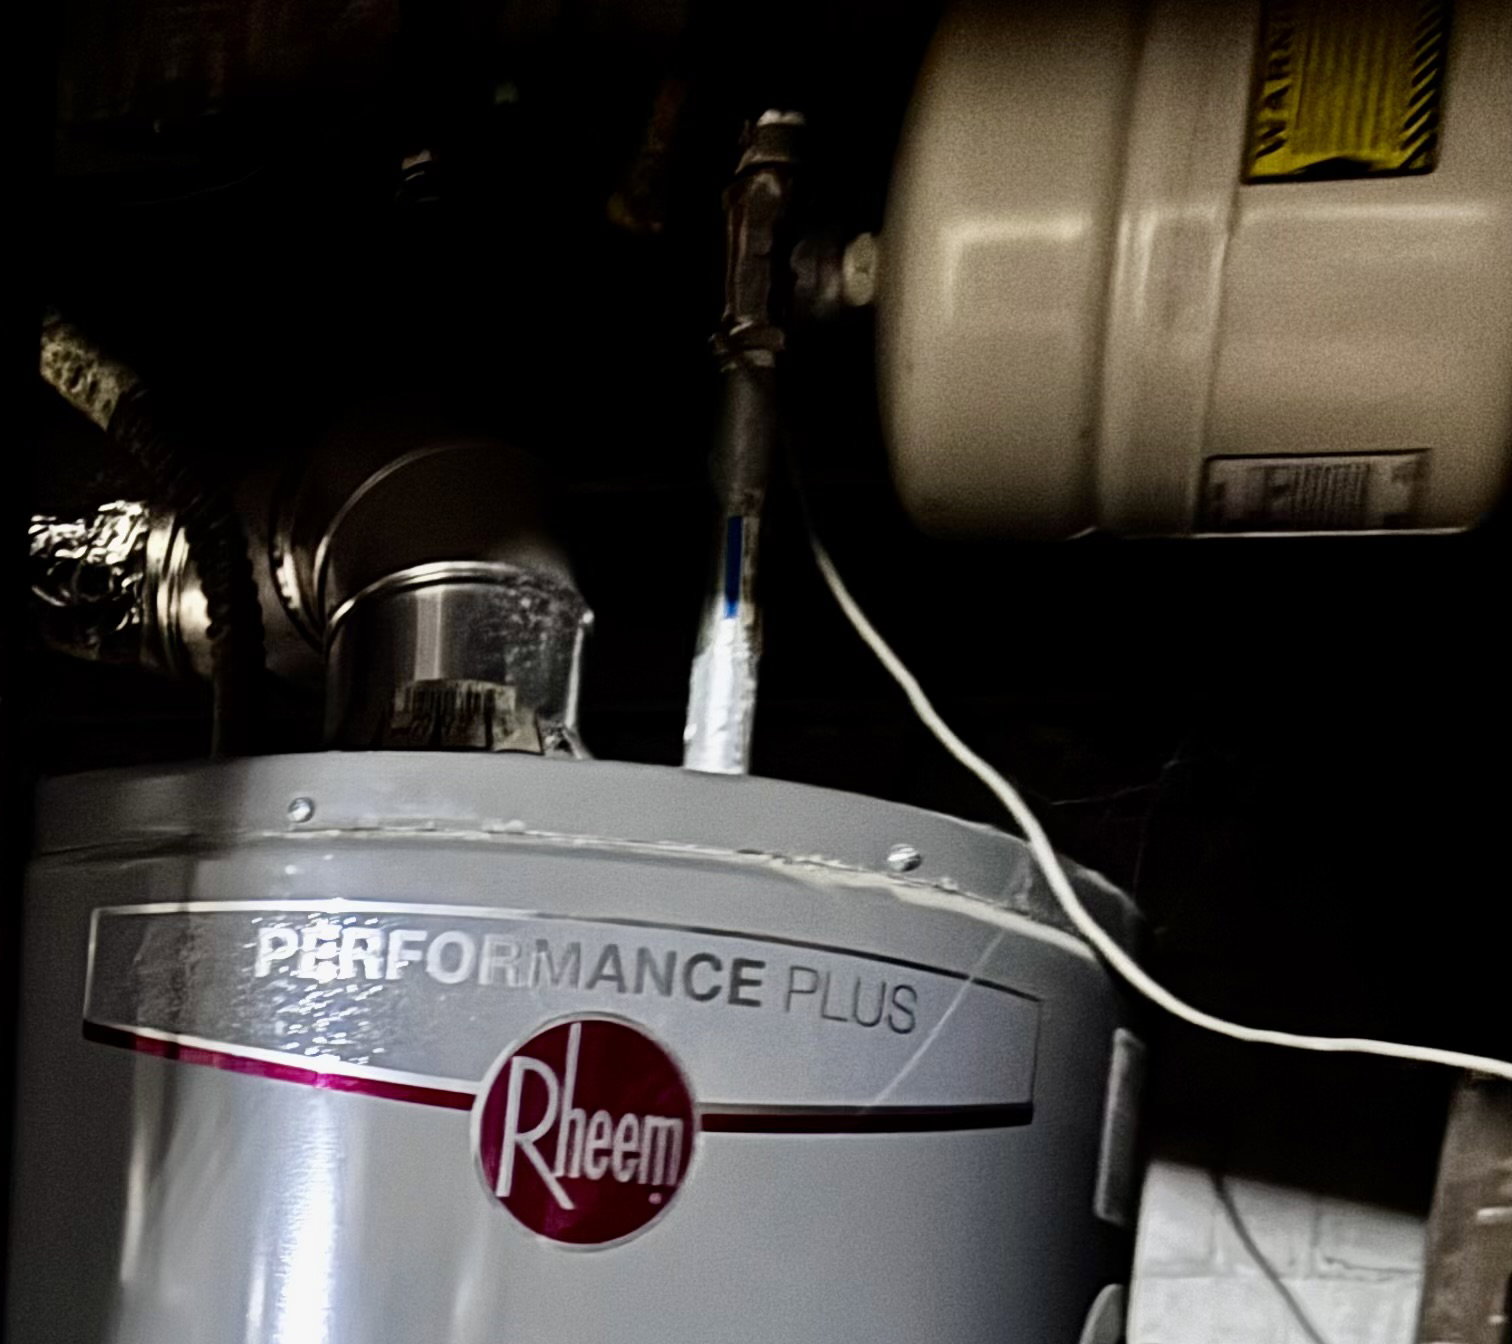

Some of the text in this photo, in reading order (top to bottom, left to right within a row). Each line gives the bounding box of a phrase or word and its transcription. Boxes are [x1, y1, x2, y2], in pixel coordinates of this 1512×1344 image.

[253, 924, 918, 1036] PERFORMANCE PLUS
[495, 1021, 685, 1211] Rheem
